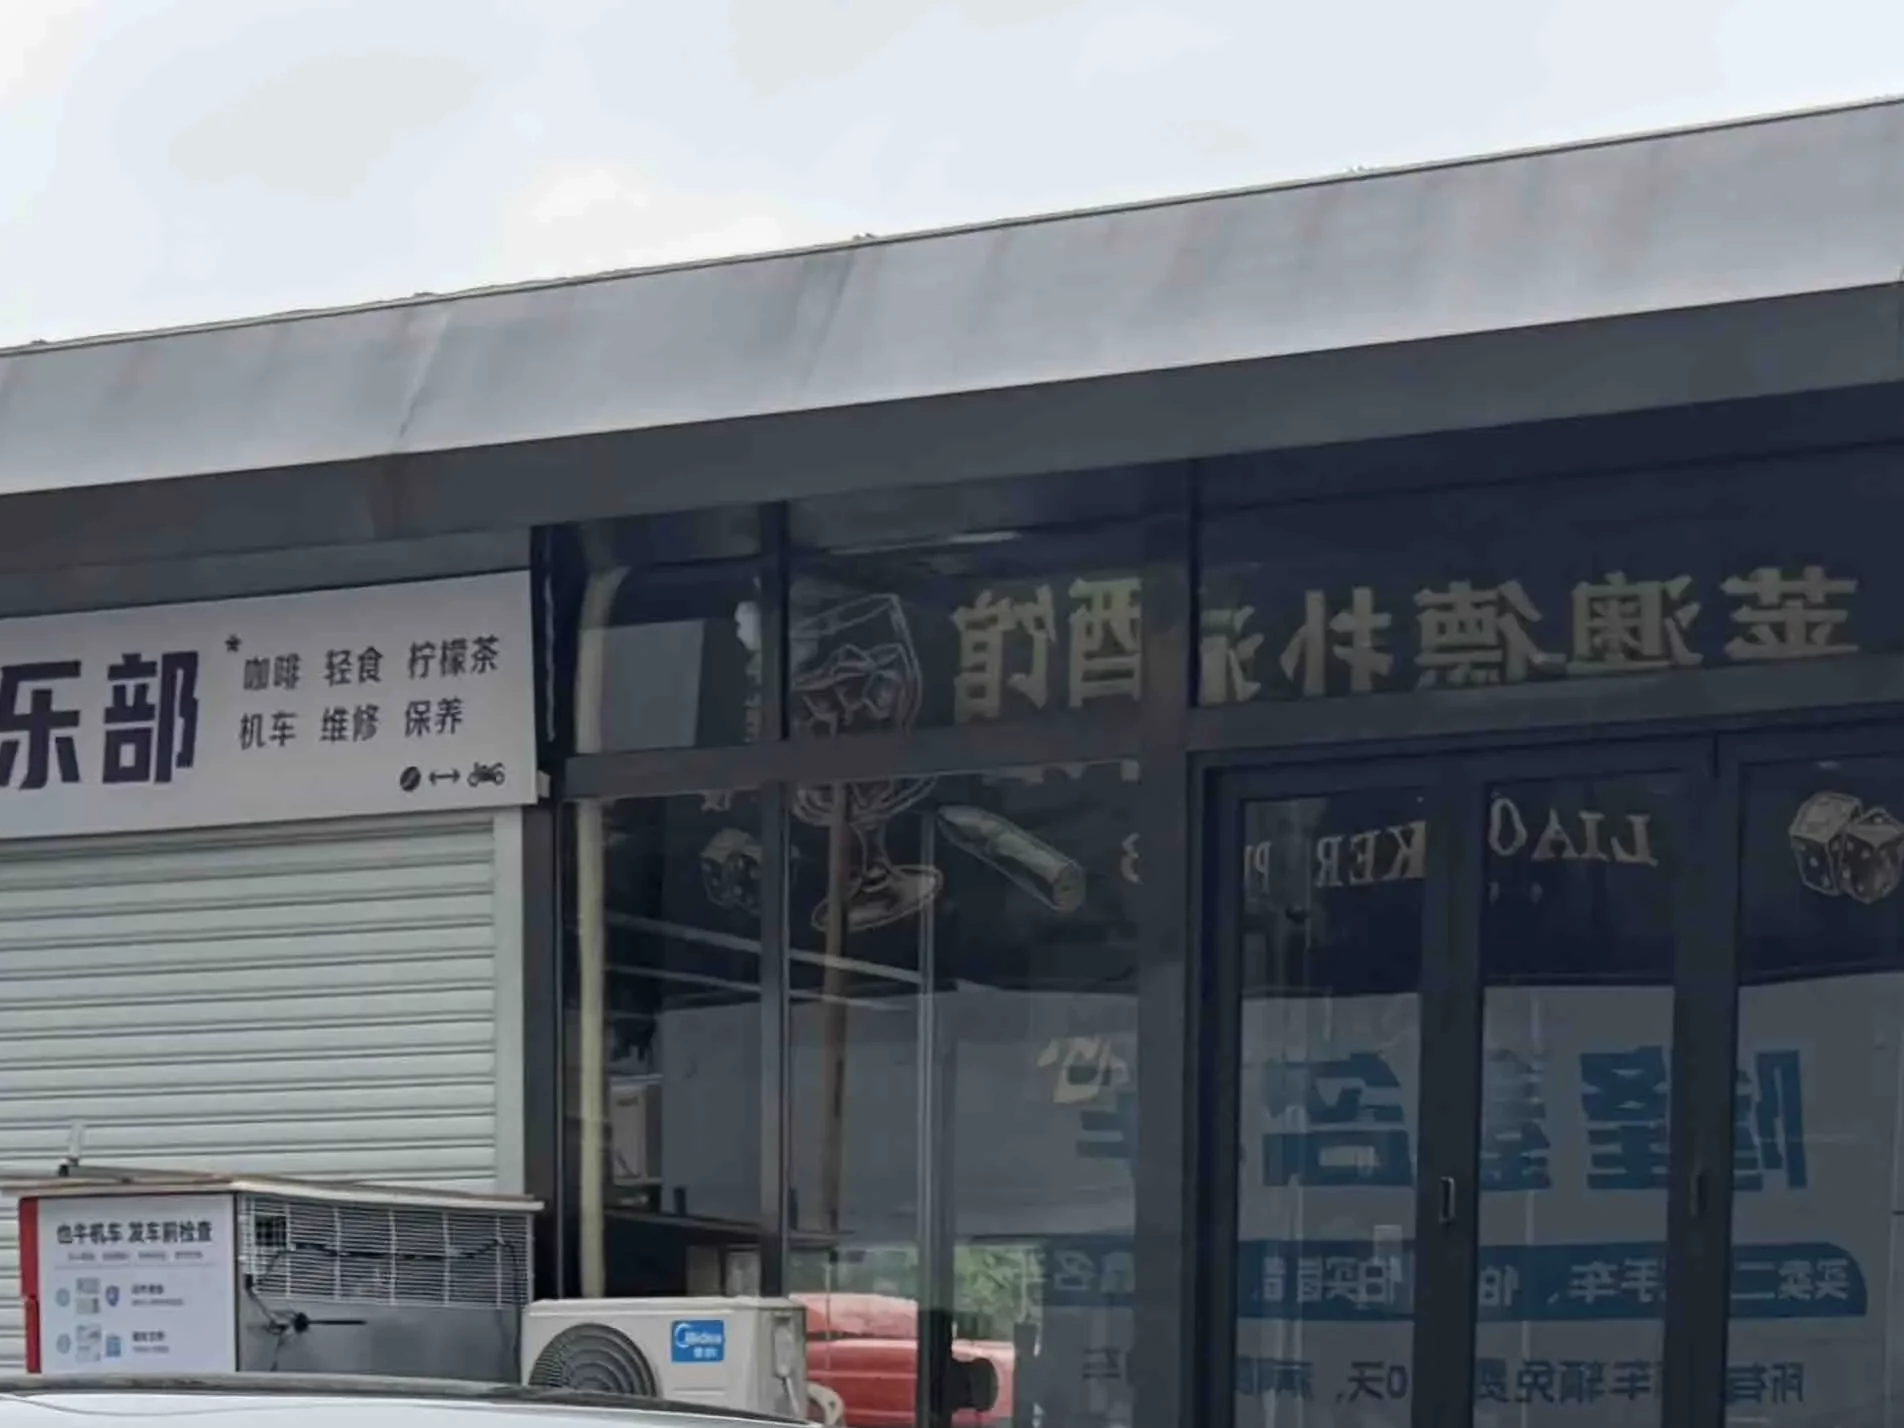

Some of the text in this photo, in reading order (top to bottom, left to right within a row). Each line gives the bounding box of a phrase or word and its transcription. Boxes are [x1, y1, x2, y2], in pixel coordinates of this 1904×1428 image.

[243, 634, 500, 691] 咖啡 轻食 柠檬茶
[239, 697, 464, 751] 机车 维修 保养
